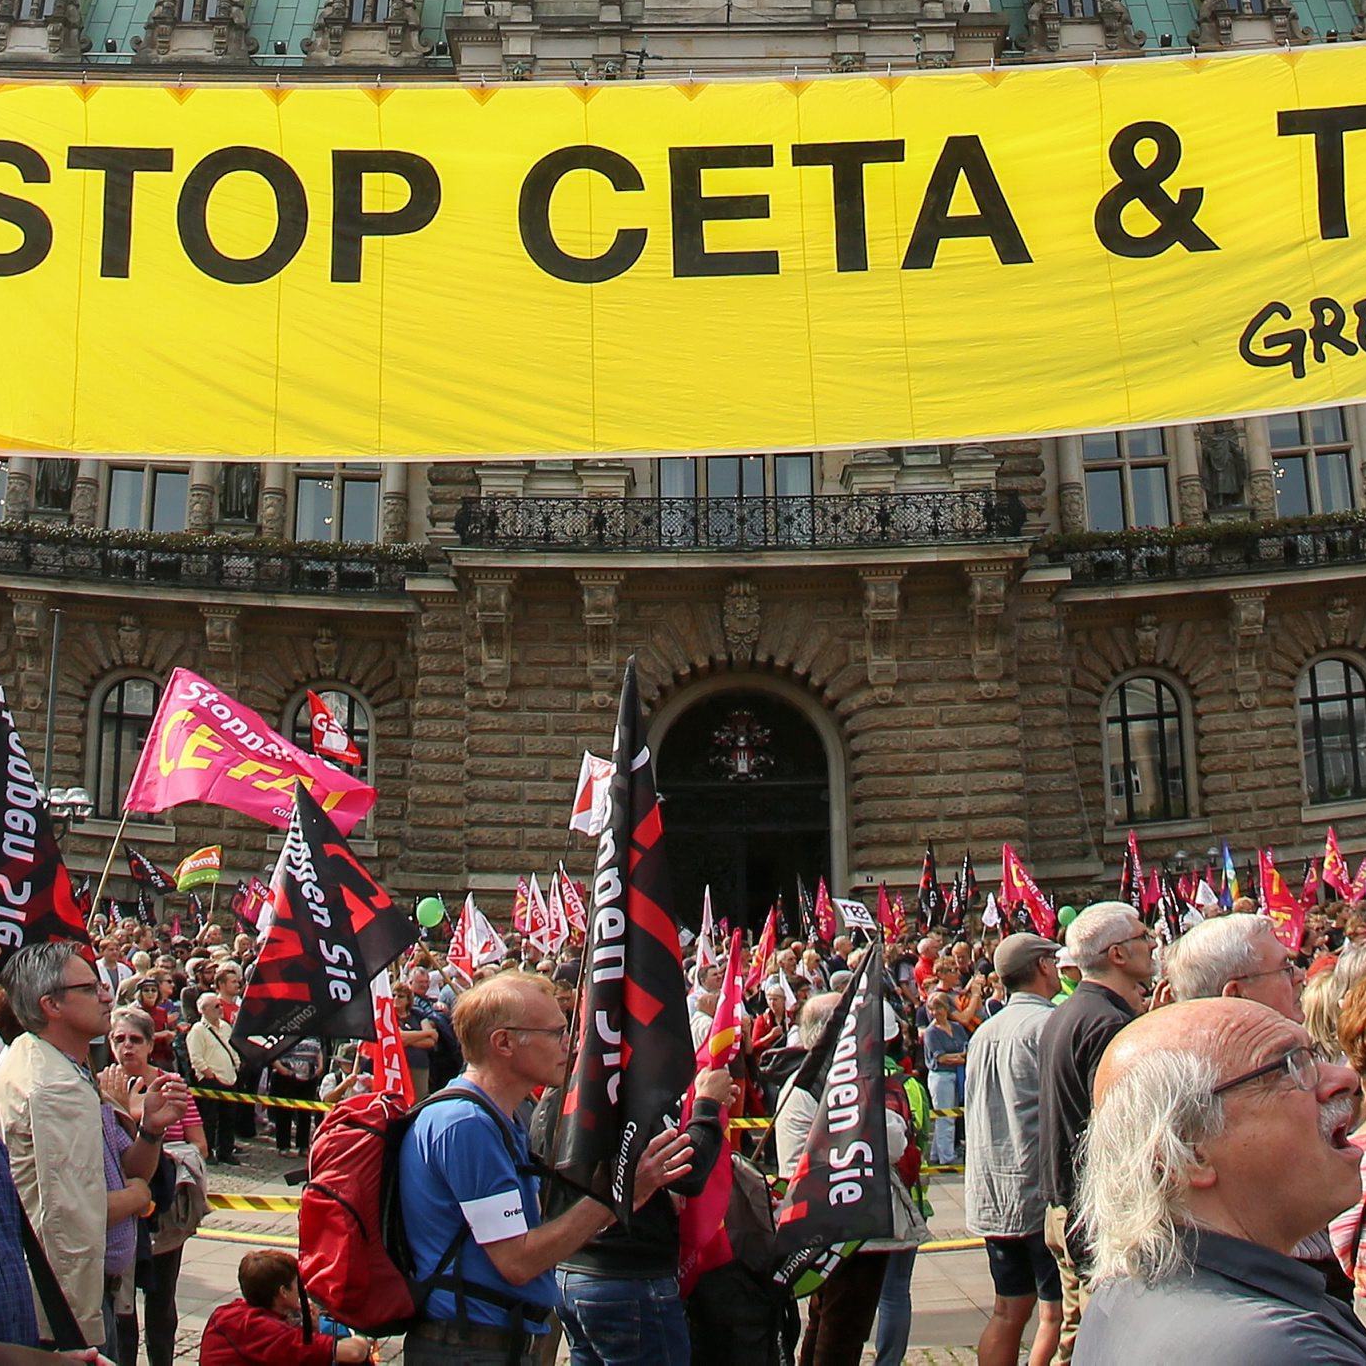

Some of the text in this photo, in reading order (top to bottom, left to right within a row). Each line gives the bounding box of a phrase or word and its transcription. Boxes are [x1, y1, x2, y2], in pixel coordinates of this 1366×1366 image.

[518, 135, 1034, 285] CETA
[1094, 120, 1222, 259] &
[320, 940, 359, 1004] Sie
[827, 1140, 874, 1208] Sie
